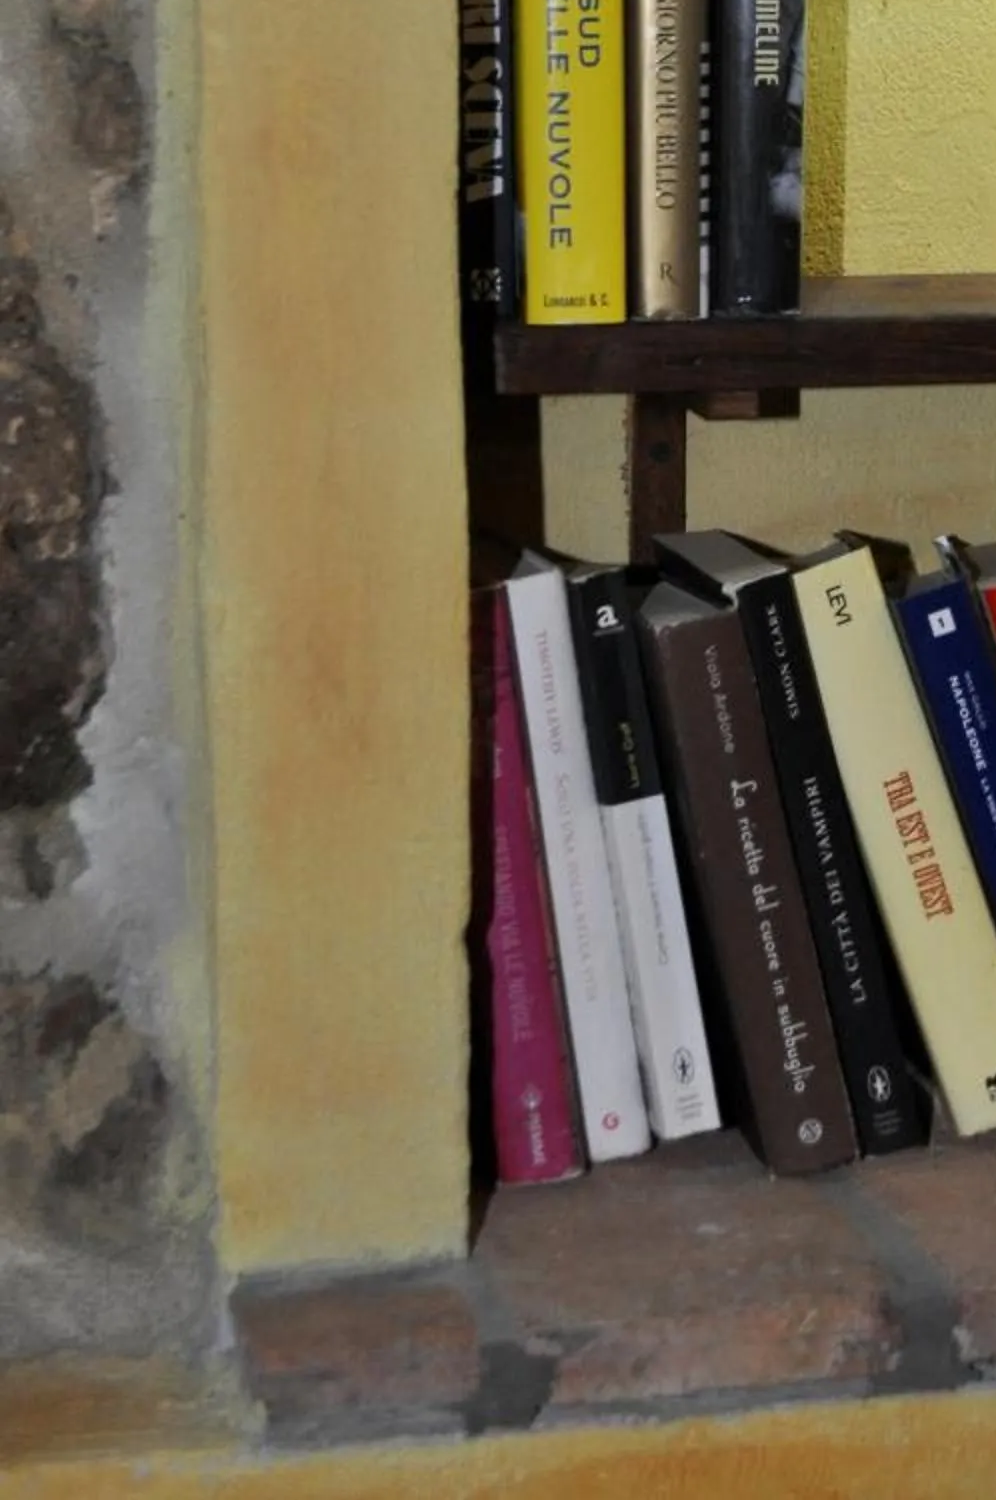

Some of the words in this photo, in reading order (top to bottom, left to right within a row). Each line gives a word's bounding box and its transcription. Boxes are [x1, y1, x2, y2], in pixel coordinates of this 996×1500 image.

[464, 57, 502, 204] SCENA
[547, 91, 571, 248] NUVOLE
[654, 134, 679, 210] BELLO
[766, 603, 787, 657] CLARK
[826, 584, 851, 626] LEVI
[779, 663, 800, 718] SIMON
[948, 675, 985, 771] NAPOLEONE
[882, 770, 917, 812] TRA
[737, 815, 766, 876] ricetta
[803, 776, 835, 863] VAMPIRI
[896, 810, 929, 848] EST
[908, 847, 935, 865] E
[752, 880, 781, 912] del
[824, 868, 844, 905] DEI
[912, 863, 953, 921] OVEST
[759, 919, 780, 970] cuore
[848, 978, 866, 1004] LA
[775, 1003, 817, 1094] subbuglio
